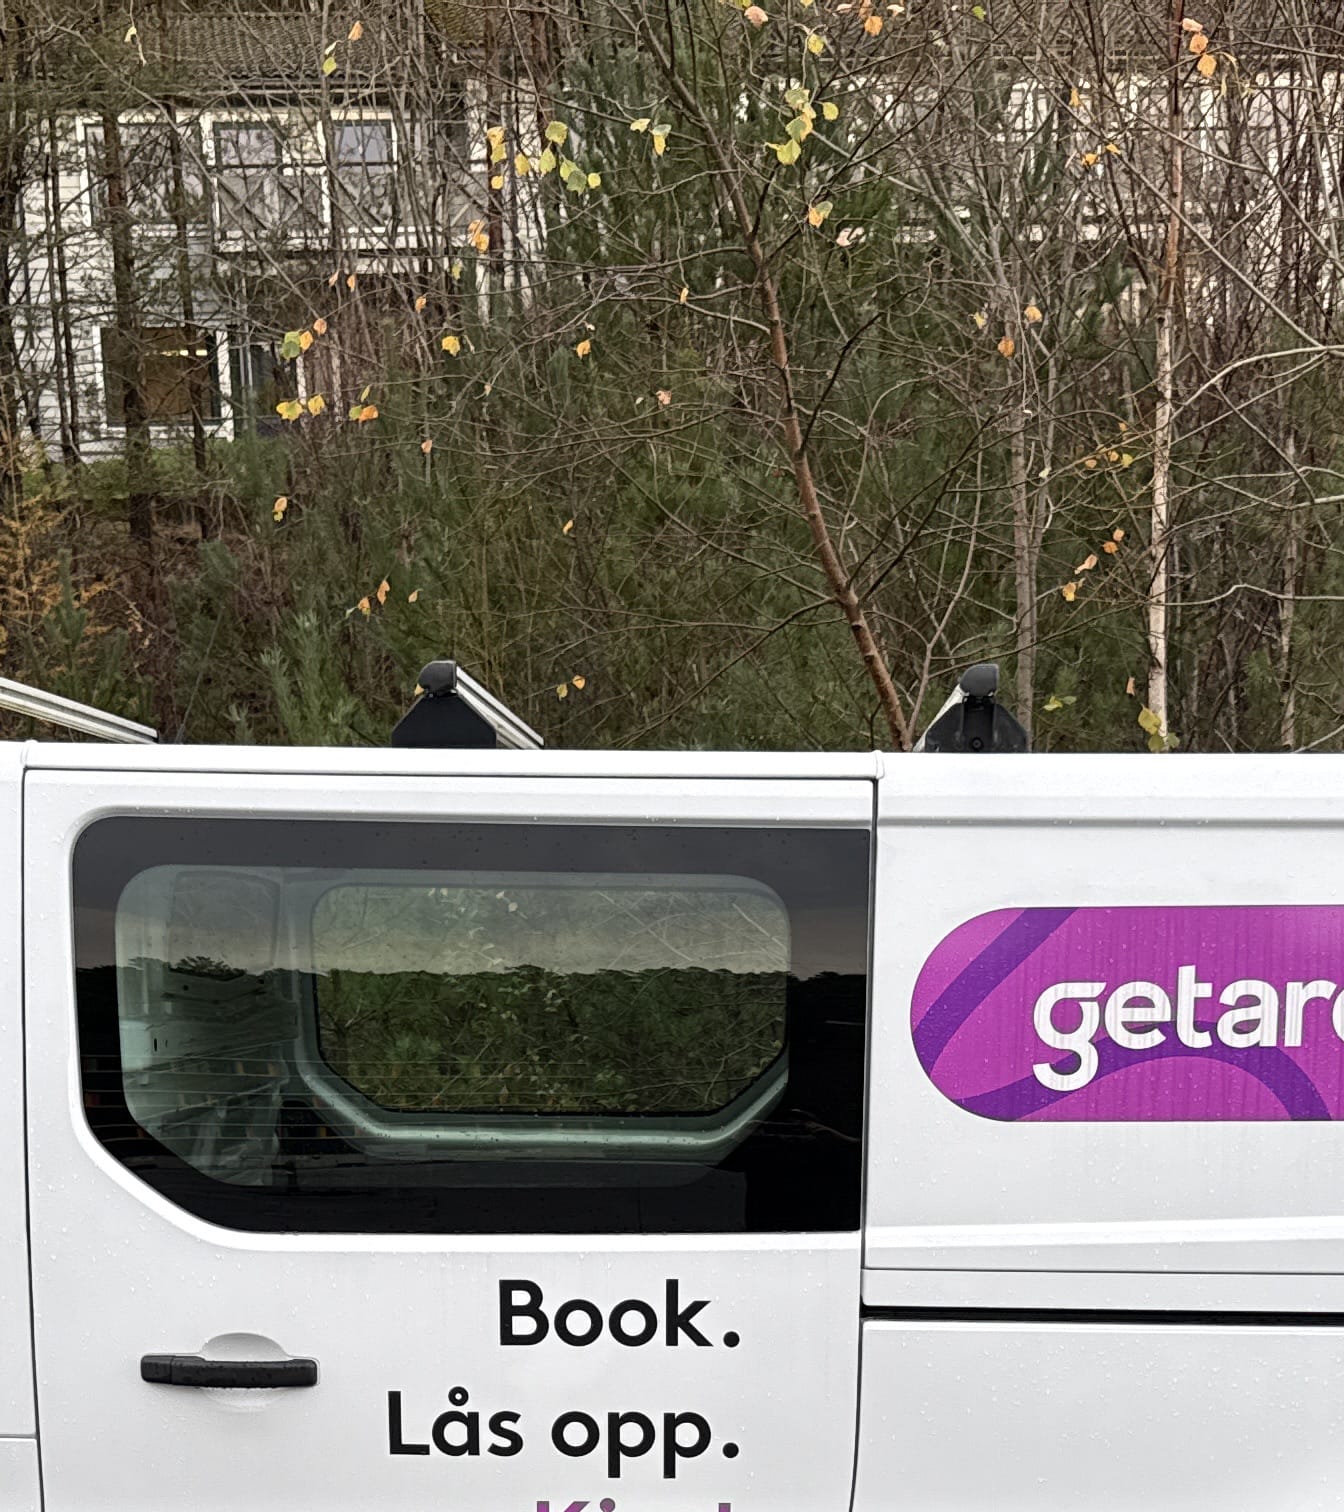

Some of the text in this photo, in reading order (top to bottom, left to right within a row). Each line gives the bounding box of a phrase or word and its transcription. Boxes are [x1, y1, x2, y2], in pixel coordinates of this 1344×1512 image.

[498, 1278, 741, 1348] Book.
[387, 1386, 740, 1479] Lås opp.
